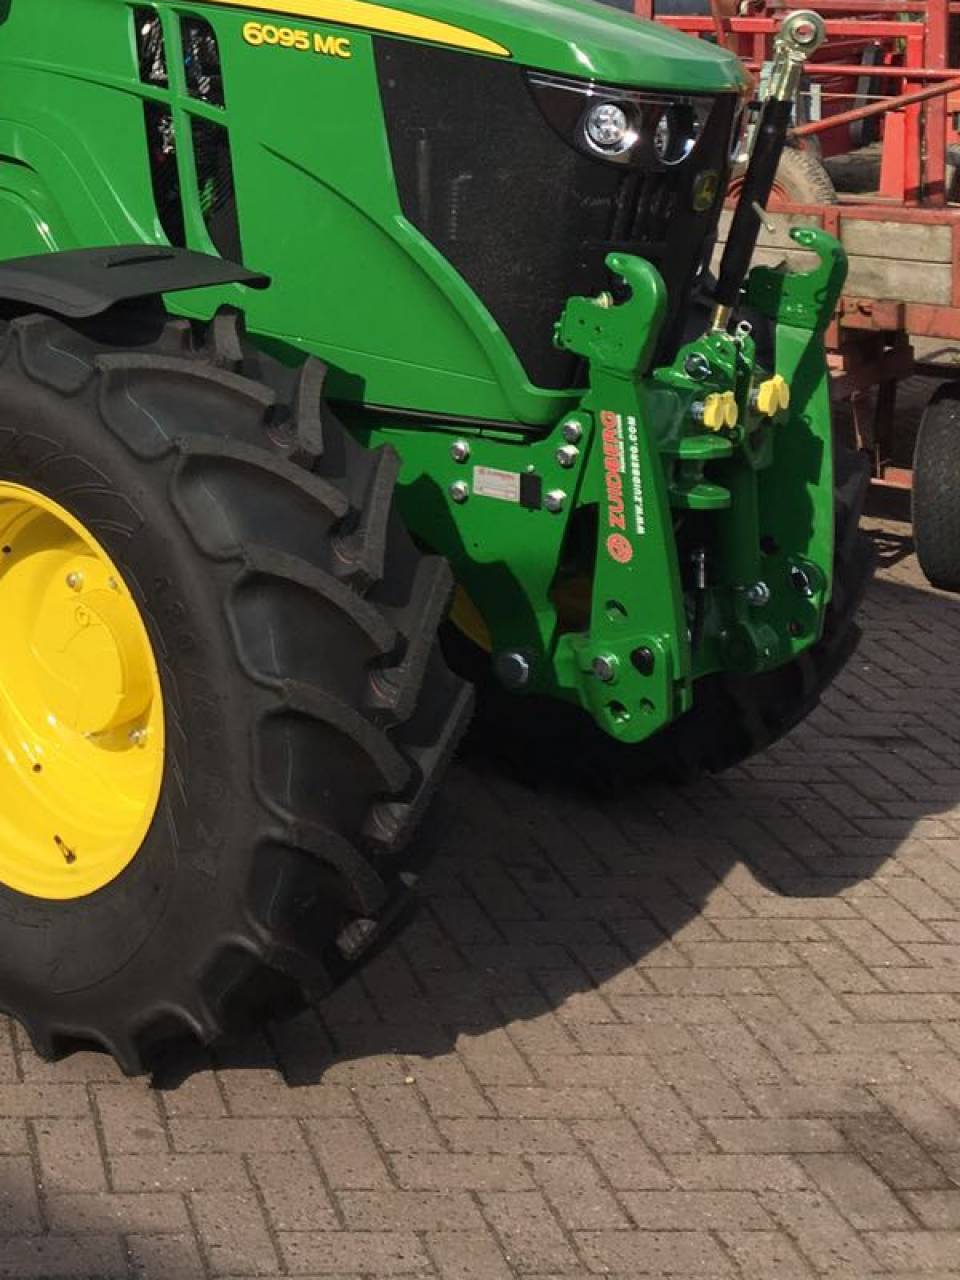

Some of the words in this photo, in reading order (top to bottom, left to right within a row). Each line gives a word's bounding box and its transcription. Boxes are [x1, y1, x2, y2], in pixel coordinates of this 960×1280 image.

[242, 21, 310, 50] 6095
[312, 32, 352, 58] MC
[600, 409, 626, 531] ZUIDBERG
